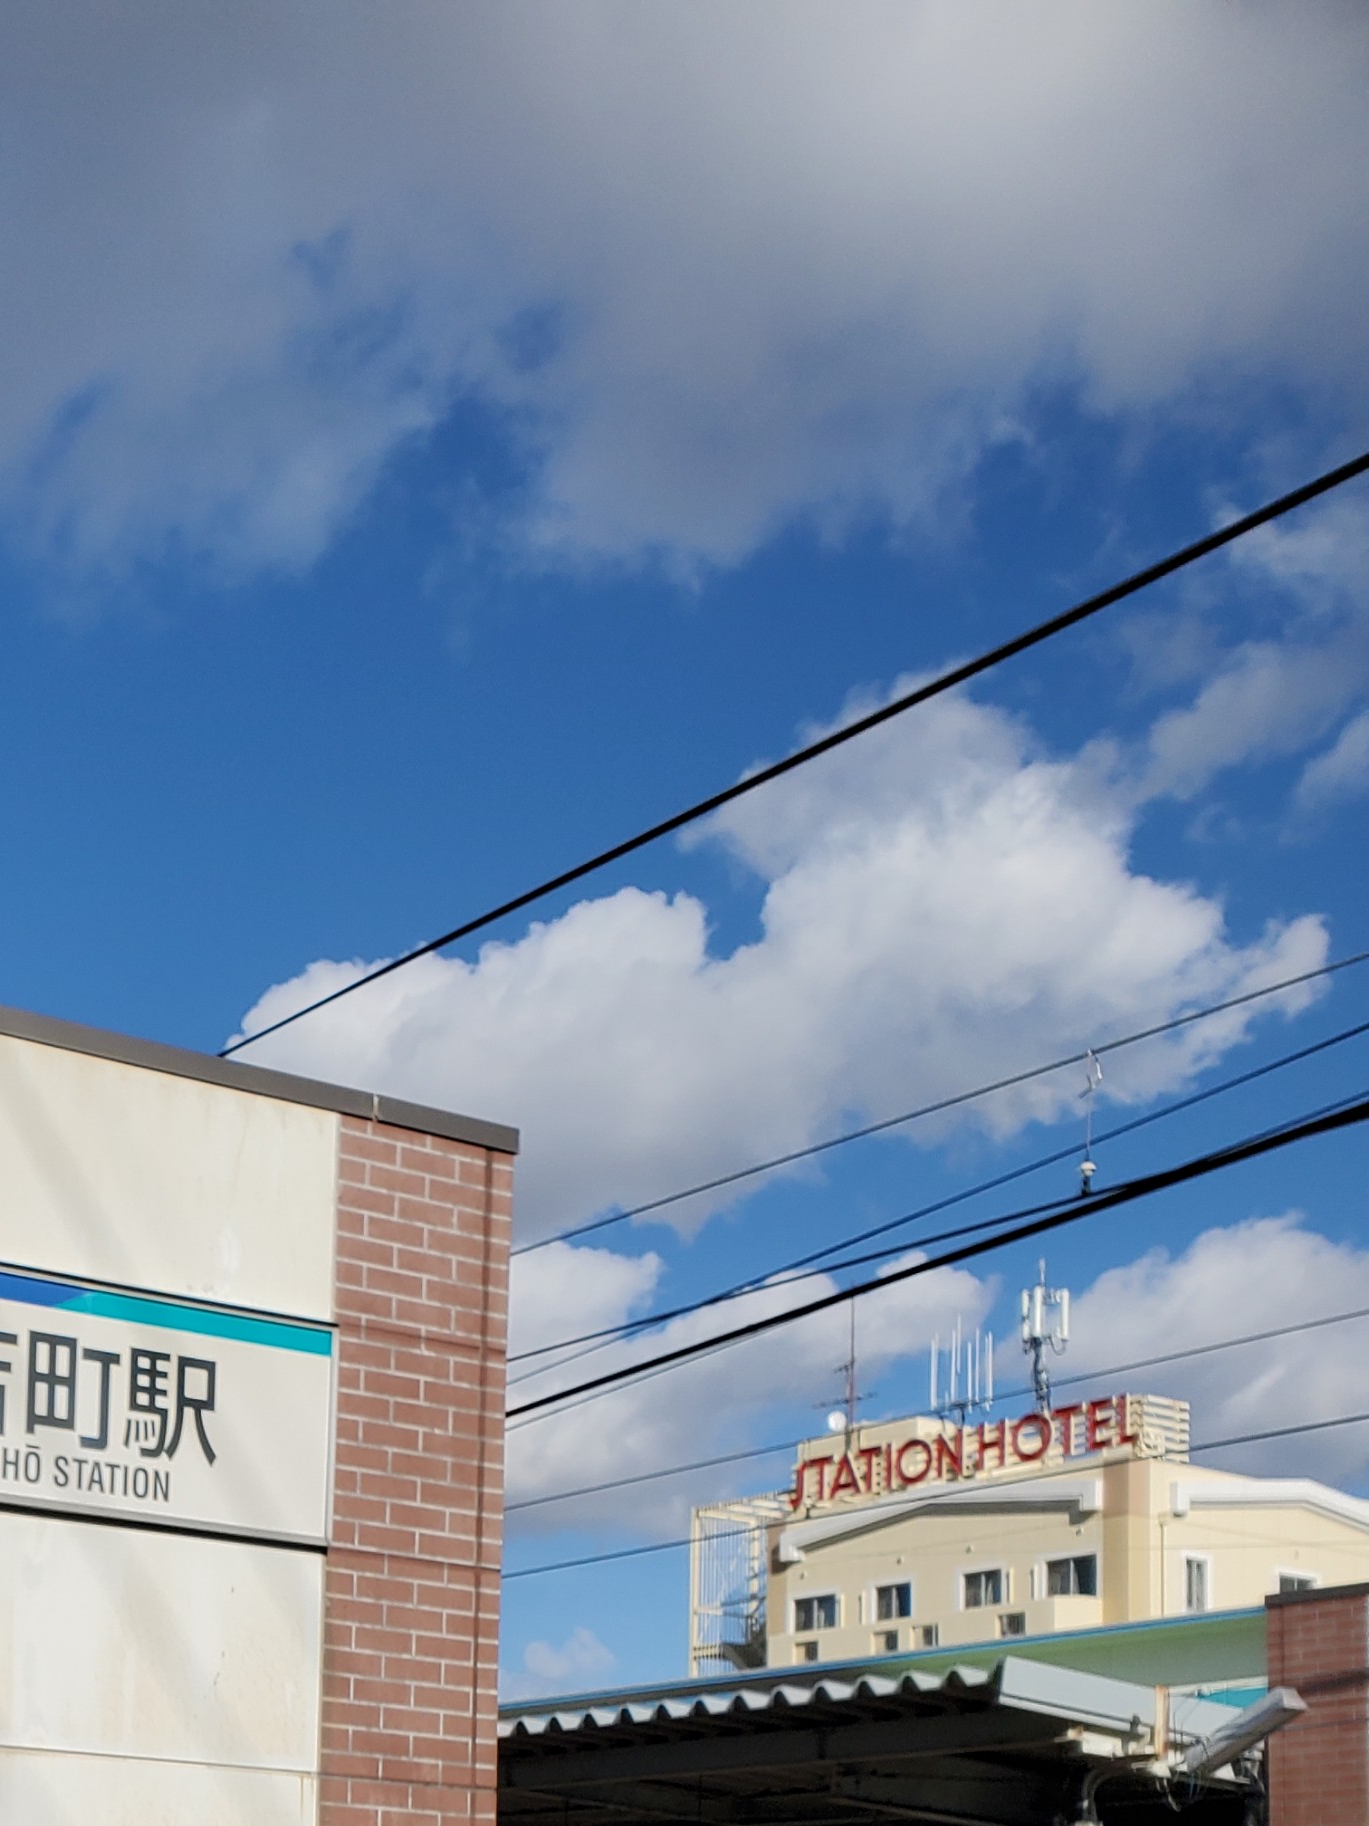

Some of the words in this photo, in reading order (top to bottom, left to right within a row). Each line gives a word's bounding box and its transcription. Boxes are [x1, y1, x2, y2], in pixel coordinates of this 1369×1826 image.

[54, 1455, 170, 1502] STATION
[789, 1431, 963, 1508] STATION
[976, 1393, 1138, 1472] HOTEL
